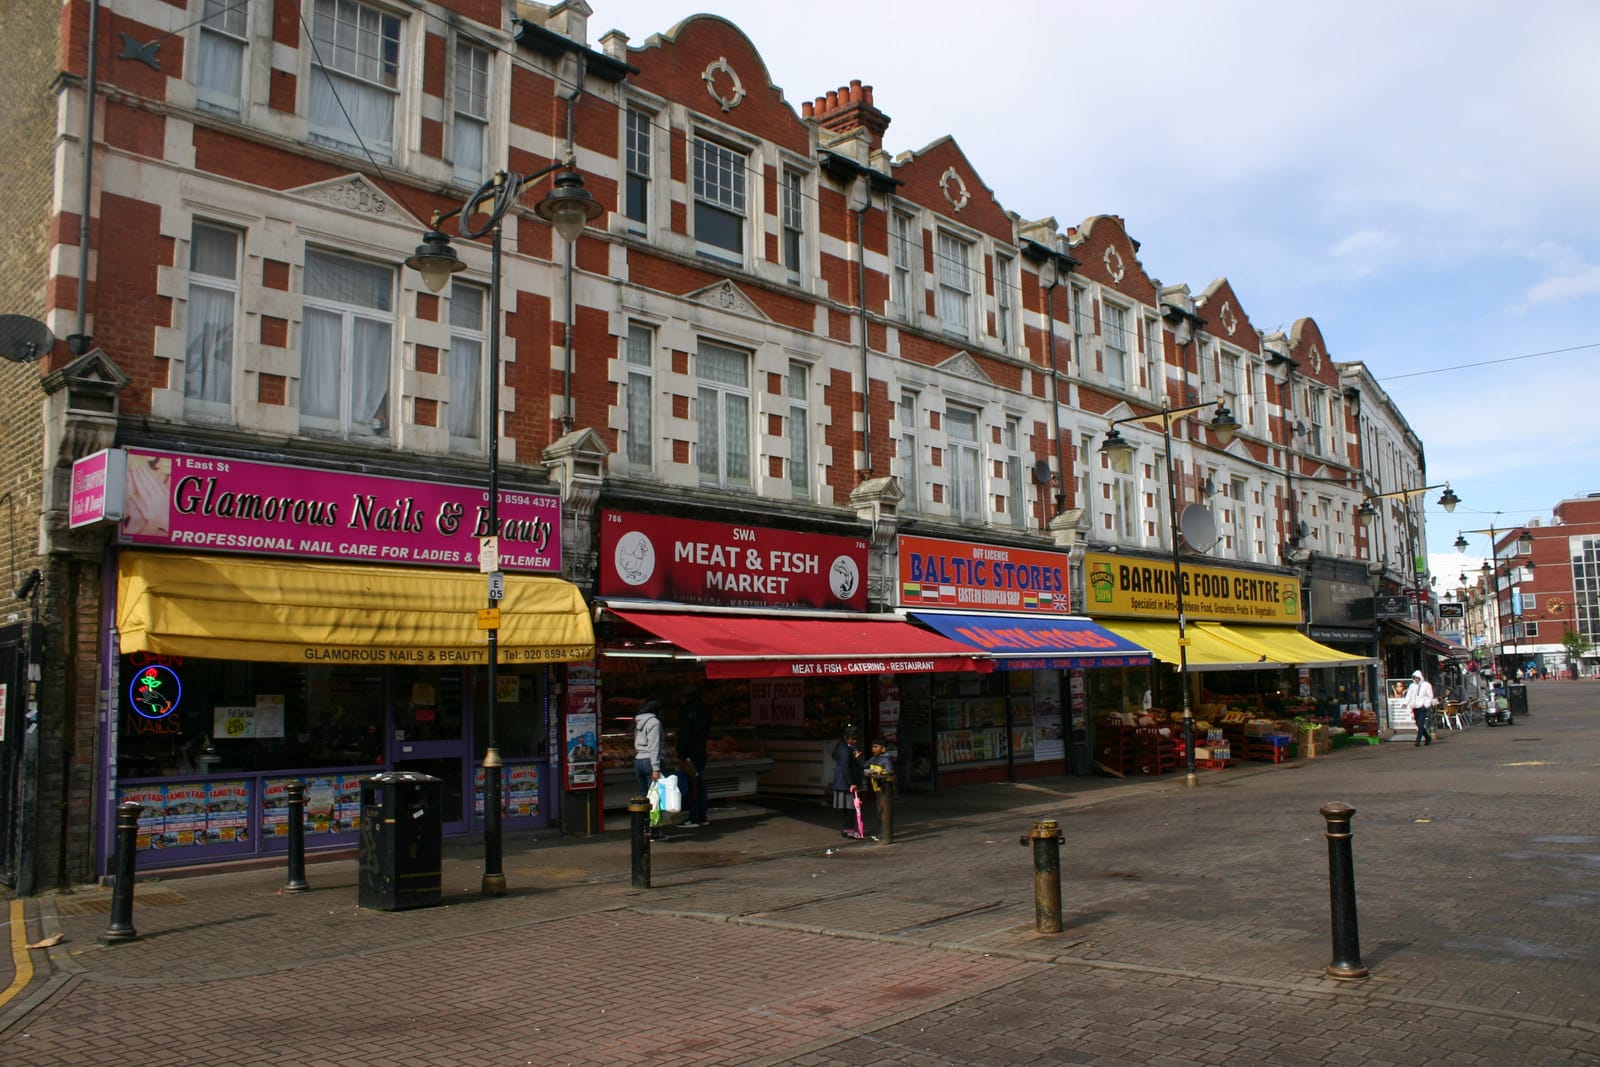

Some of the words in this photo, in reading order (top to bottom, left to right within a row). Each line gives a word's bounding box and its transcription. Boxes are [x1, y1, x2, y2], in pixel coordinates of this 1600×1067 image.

[175, 458, 181, 467] 1
[186, 459, 213, 471] East
[217, 462, 230, 473] St
[173, 475, 338, 527] Glamorous
[347, 493, 424, 533] Nails
[436, 502, 464, 537] &
[482, 492, 502, 503] 00
[505, 494, 530, 506] 8594
[532, 497, 557, 509] 4372
[607, 514, 622, 523] 786
[733, 528, 756, 542] SWA
[170, 530, 294, 550] PROFESSIONAL
[299, 540, 334, 553] NAIL
[339, 543, 377, 556] CARE
[381, 546, 408, 559] FOR
[413, 548, 460, 562] LADIES
[464, 552, 473, 562] &
[477, 553, 551, 568] NTLEMEN
[972, 548, 984, 561] OFF
[985, 549, 1009, 562] LICENCE
[674, 541, 741, 568] MEAT
[745, 548, 763, 570] &
[769, 550, 819, 575] FISH
[909, 552, 987, 587] BALTIC
[992, 561, 1063, 592] STORES
[493, 580, 499, 589] E
[706, 570, 789, 595] MARKET
[1119, 565, 1190, 596] BARKING
[1194, 573, 1230, 598] FOOD
[1233, 577, 1280, 603] CENTRE
[490, 590, 502, 599] 05
[958, 587, 982, 603] EASTERN
[982, 589, 1007, 605] EUROPEAN
[1007, 591, 1020, 605] SHOP
[1131, 598, 1157, 611] Specialist
[304, 649, 386, 660] GLAMOROUS
[389, 650, 424, 661] NAILS
[427, 651, 436, 661] &
[439, 651, 484, 661] BEAUTY
[504, 650, 521, 660] Tel:
[524, 650, 542, 659] 020
[544, 649, 566, 659] 8594
[792, 664, 815, 673] MEAT
[816, 664, 822, 673] &
[824, 663, 843, 673] FISH
[847, 662, 886, 672] CATERING
[890, 661, 935, 671] RESTAURANT
